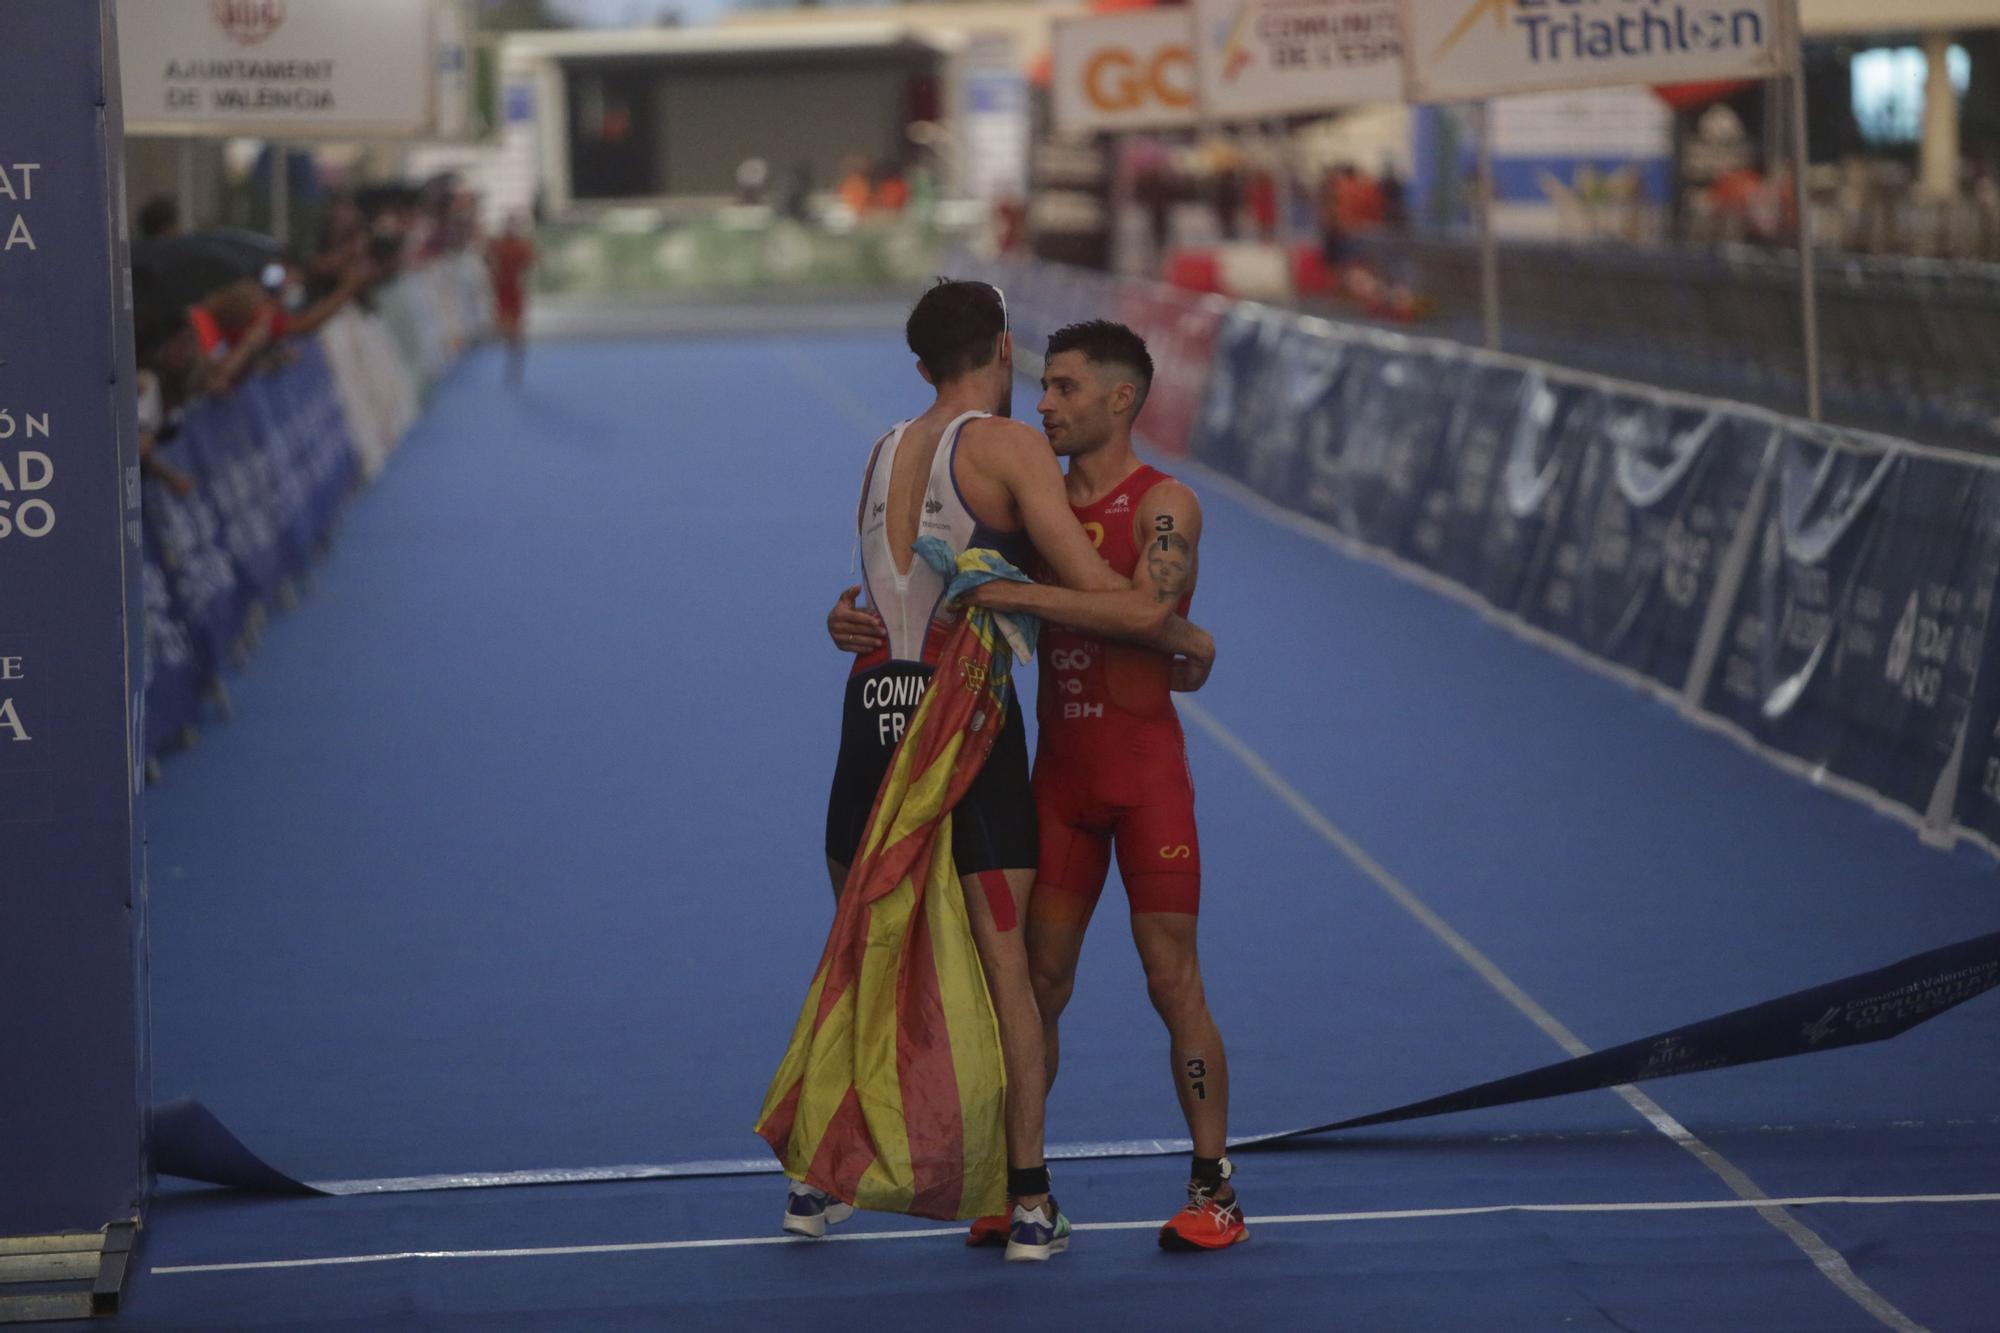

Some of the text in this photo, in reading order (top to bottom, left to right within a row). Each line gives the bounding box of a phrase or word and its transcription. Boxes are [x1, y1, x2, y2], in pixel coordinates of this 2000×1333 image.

[1513, 5, 1764, 64] Triathlon
[165, 59, 336, 80] AJUNTAMENT
[165, 86, 336, 111] DE VALENCIA
[1051, 648, 1091, 671] GO
[1063, 702, 1105, 719] BH
